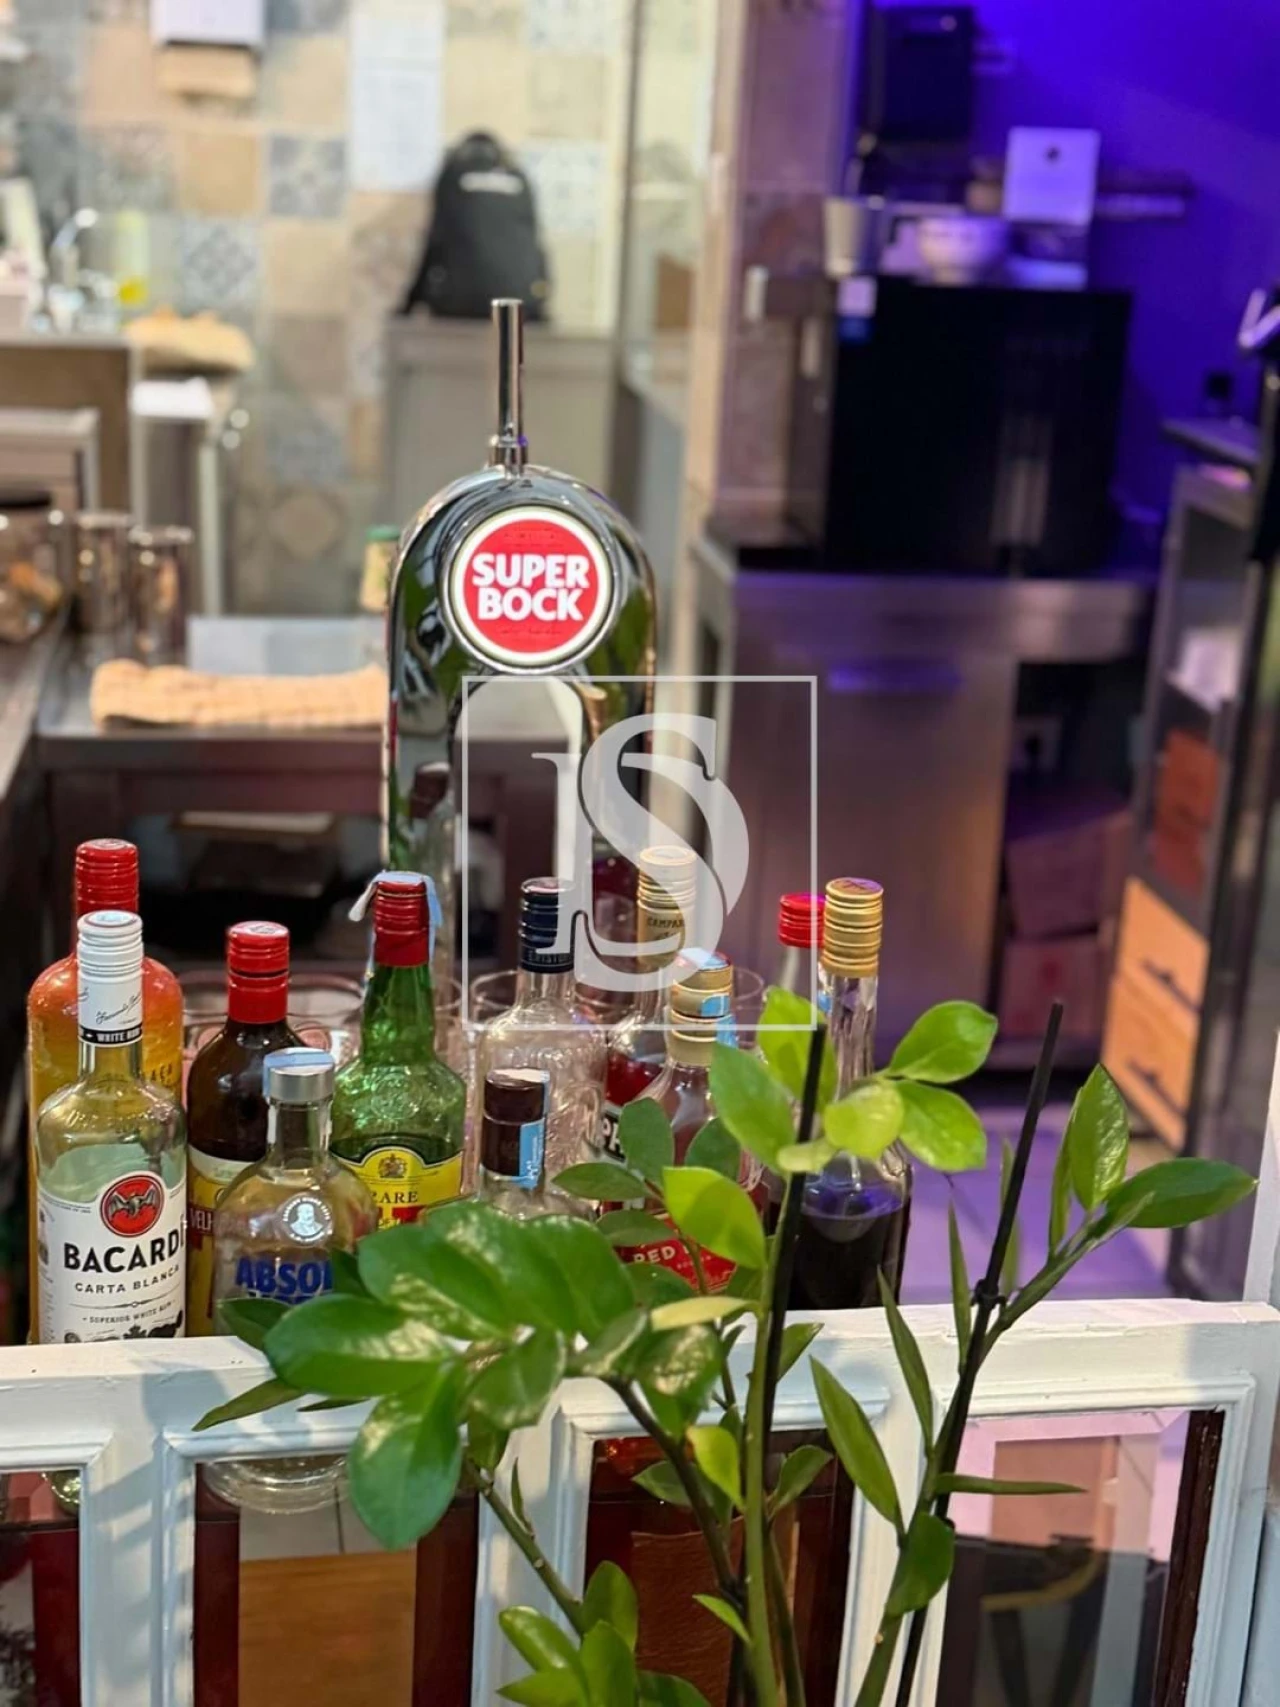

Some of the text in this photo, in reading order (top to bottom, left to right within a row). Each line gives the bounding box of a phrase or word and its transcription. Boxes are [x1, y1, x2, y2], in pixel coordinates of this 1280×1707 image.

[471, 552, 590, 589] SUPER
[477, 587, 584, 621] BOCK
[75, 1264, 180, 1294] CARTA BLANCA
[89, 1315, 131, 1324] SUPERIOR
[132, 1308, 157, 1321] WHITE
